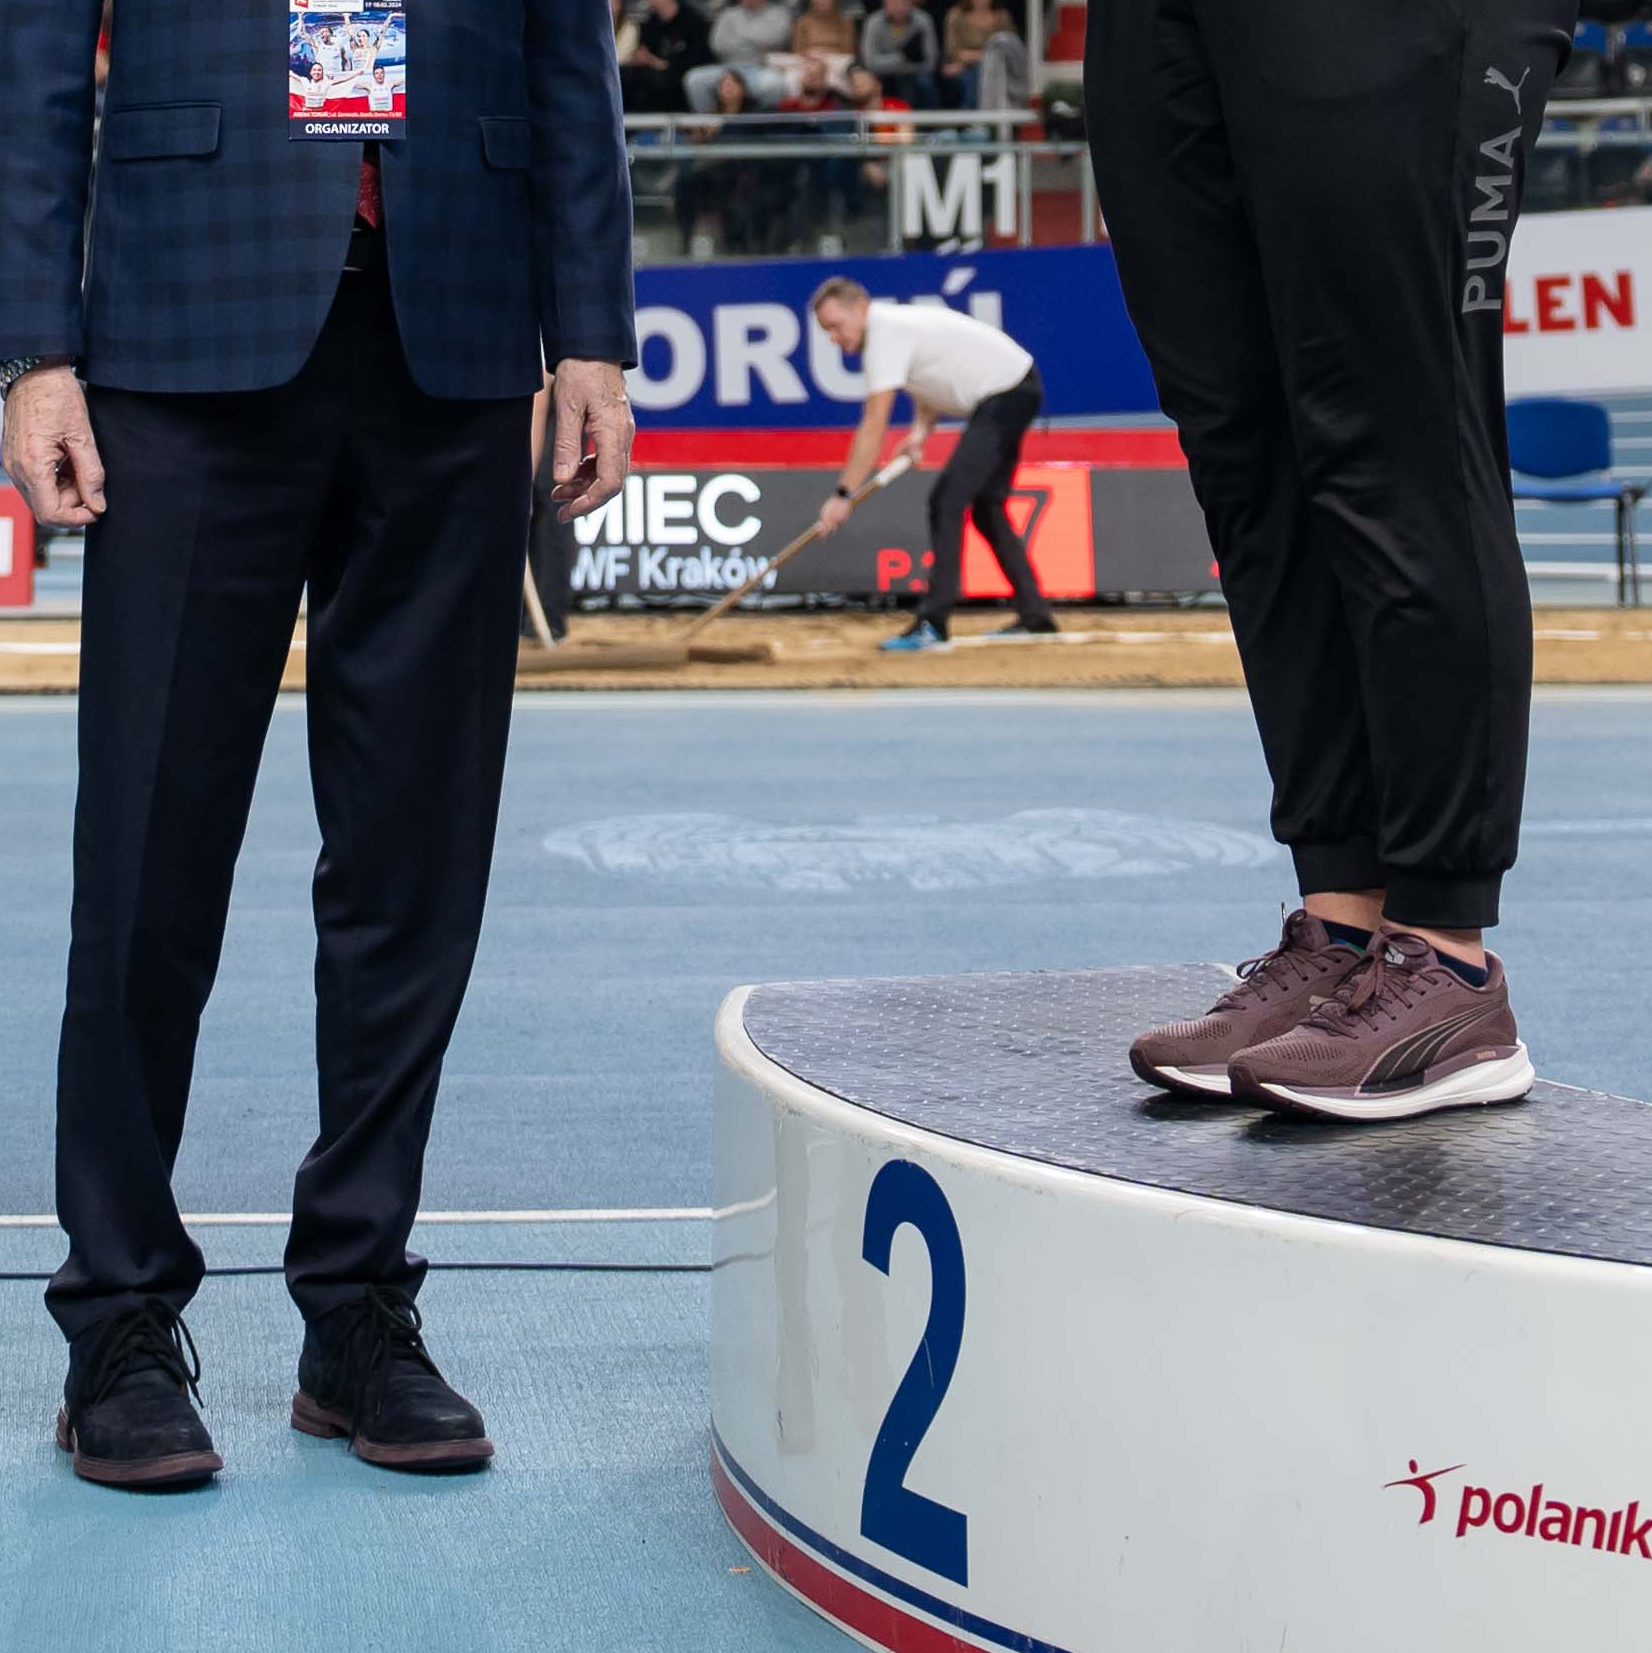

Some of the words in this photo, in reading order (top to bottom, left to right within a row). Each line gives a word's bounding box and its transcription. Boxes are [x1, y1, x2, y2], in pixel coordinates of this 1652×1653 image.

[305, 123, 389, 135] ORGANIZATOR
[903, 152, 1018, 238] M1
[1462, 126, 1522, 314] PUMA
[1503, 269, 1637, 336] LEN
[638, 546, 778, 591] Kraków
[860, 1158, 970, 1589] 2
